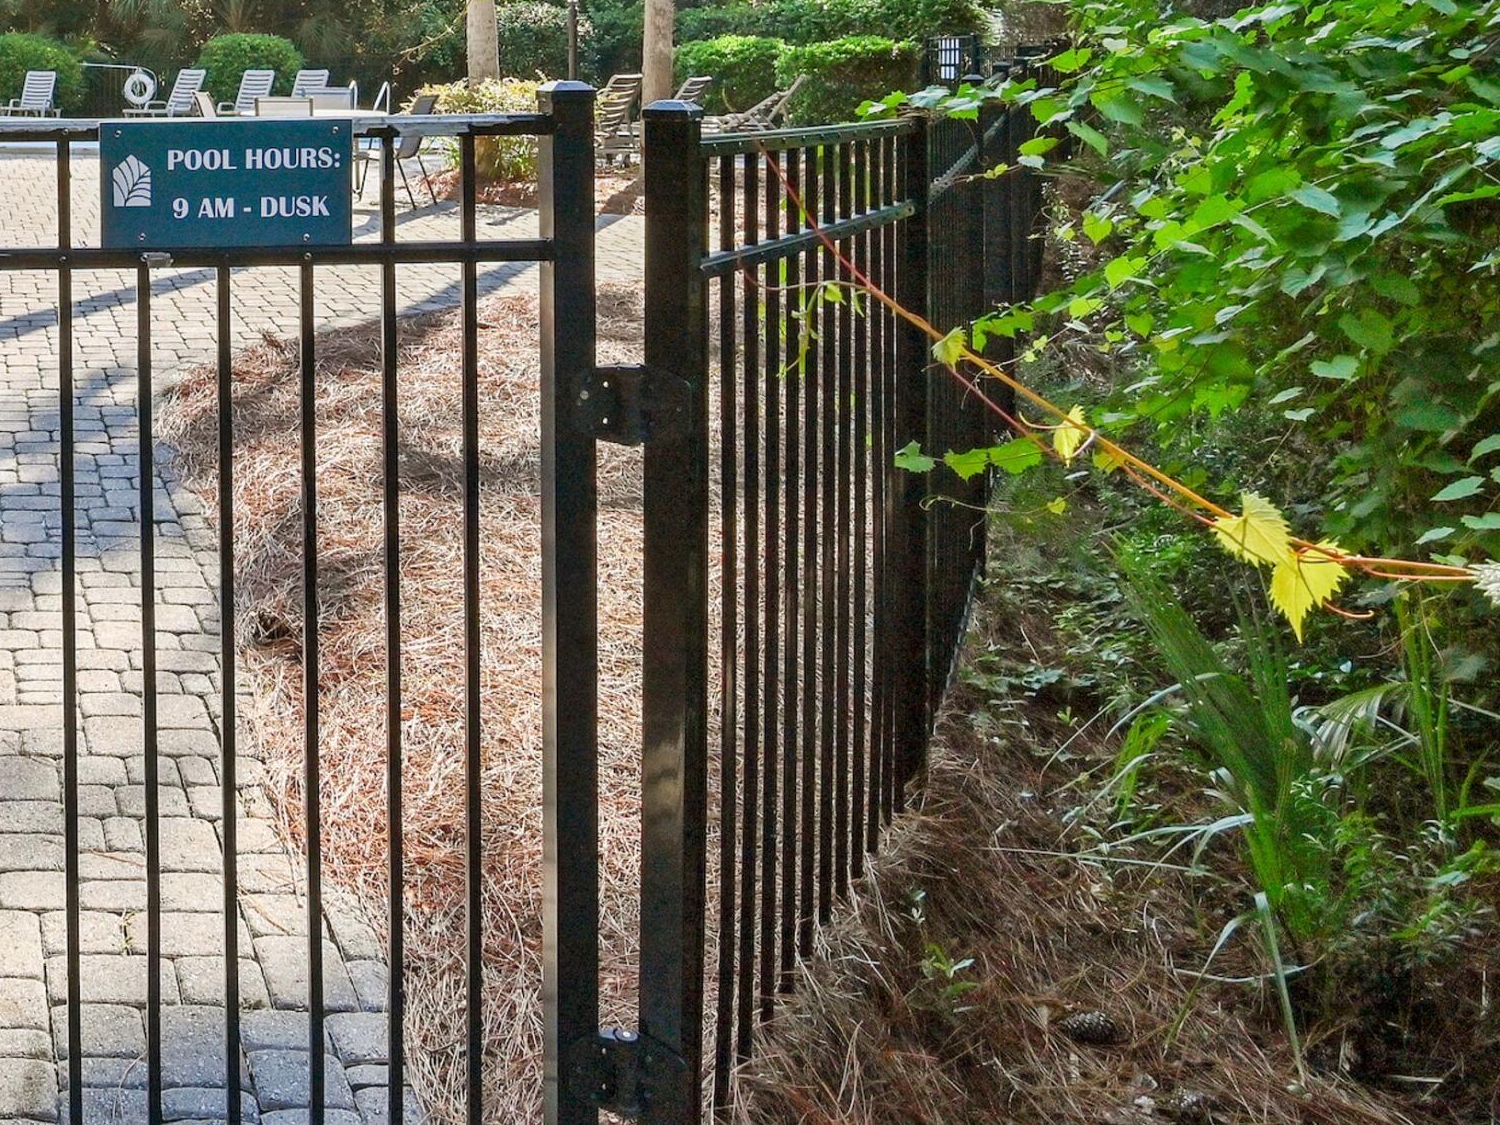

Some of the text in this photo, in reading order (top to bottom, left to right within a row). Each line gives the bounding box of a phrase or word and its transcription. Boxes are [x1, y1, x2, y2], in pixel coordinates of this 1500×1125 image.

[167, 147, 341, 171] POOL HOURS:
[172, 197, 189, 219] 9
[198, 197, 235, 218] AM
[260, 195, 330, 218] DUSK
